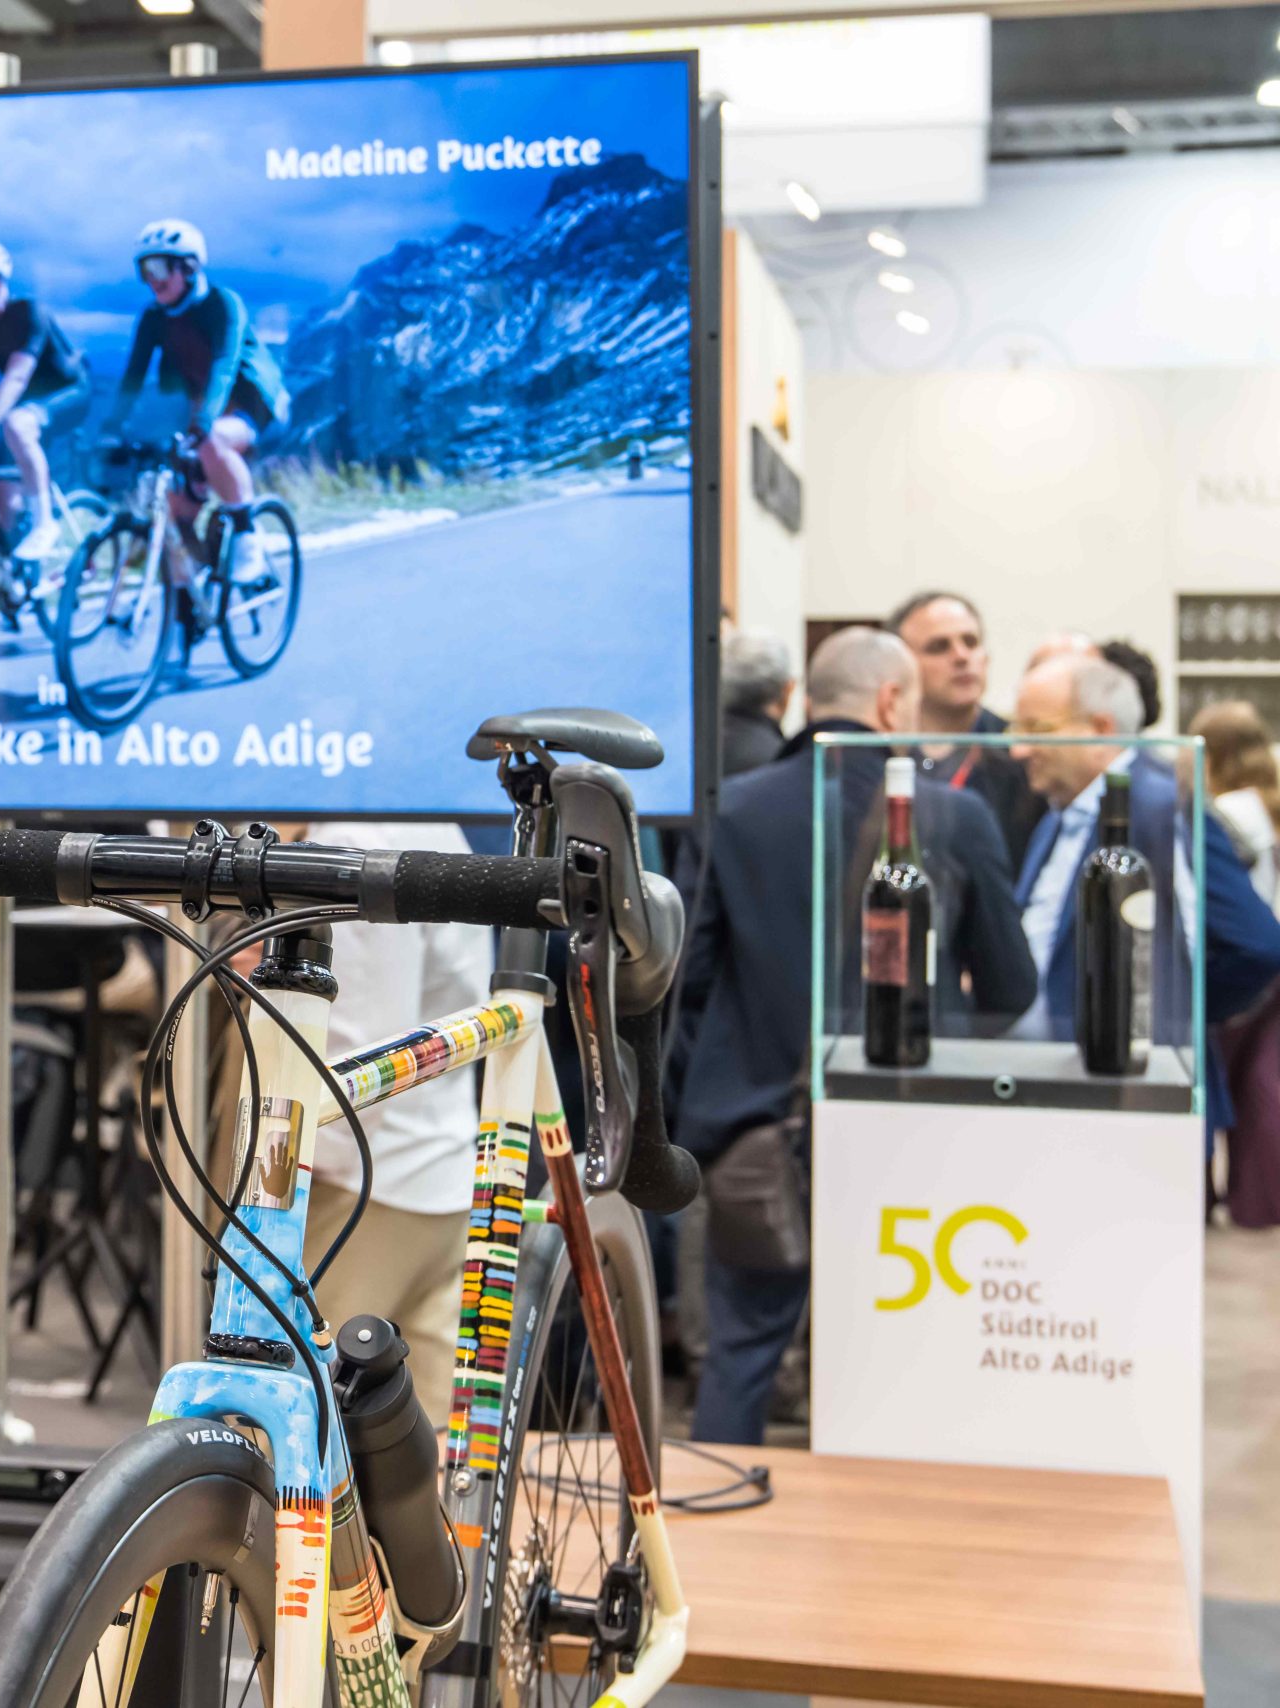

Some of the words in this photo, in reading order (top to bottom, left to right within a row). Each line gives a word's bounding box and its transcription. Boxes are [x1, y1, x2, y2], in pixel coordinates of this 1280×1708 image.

[266, 140, 428, 180] Madeline
[437, 135, 602, 172] Puckette
[37, 676, 67, 705] in
[59, 718, 103, 764] in
[116, 723, 218, 766] Alto
[234, 719, 373, 776] Adige
[980, 1280, 1043, 1304] DOC
[980, 1313, 1098, 1341] Südtirol
[980, 1348, 1041, 1371] Alto
[1051, 1352, 1134, 1380] Adige
[483, 1400, 518, 1609] VELOFLEX
